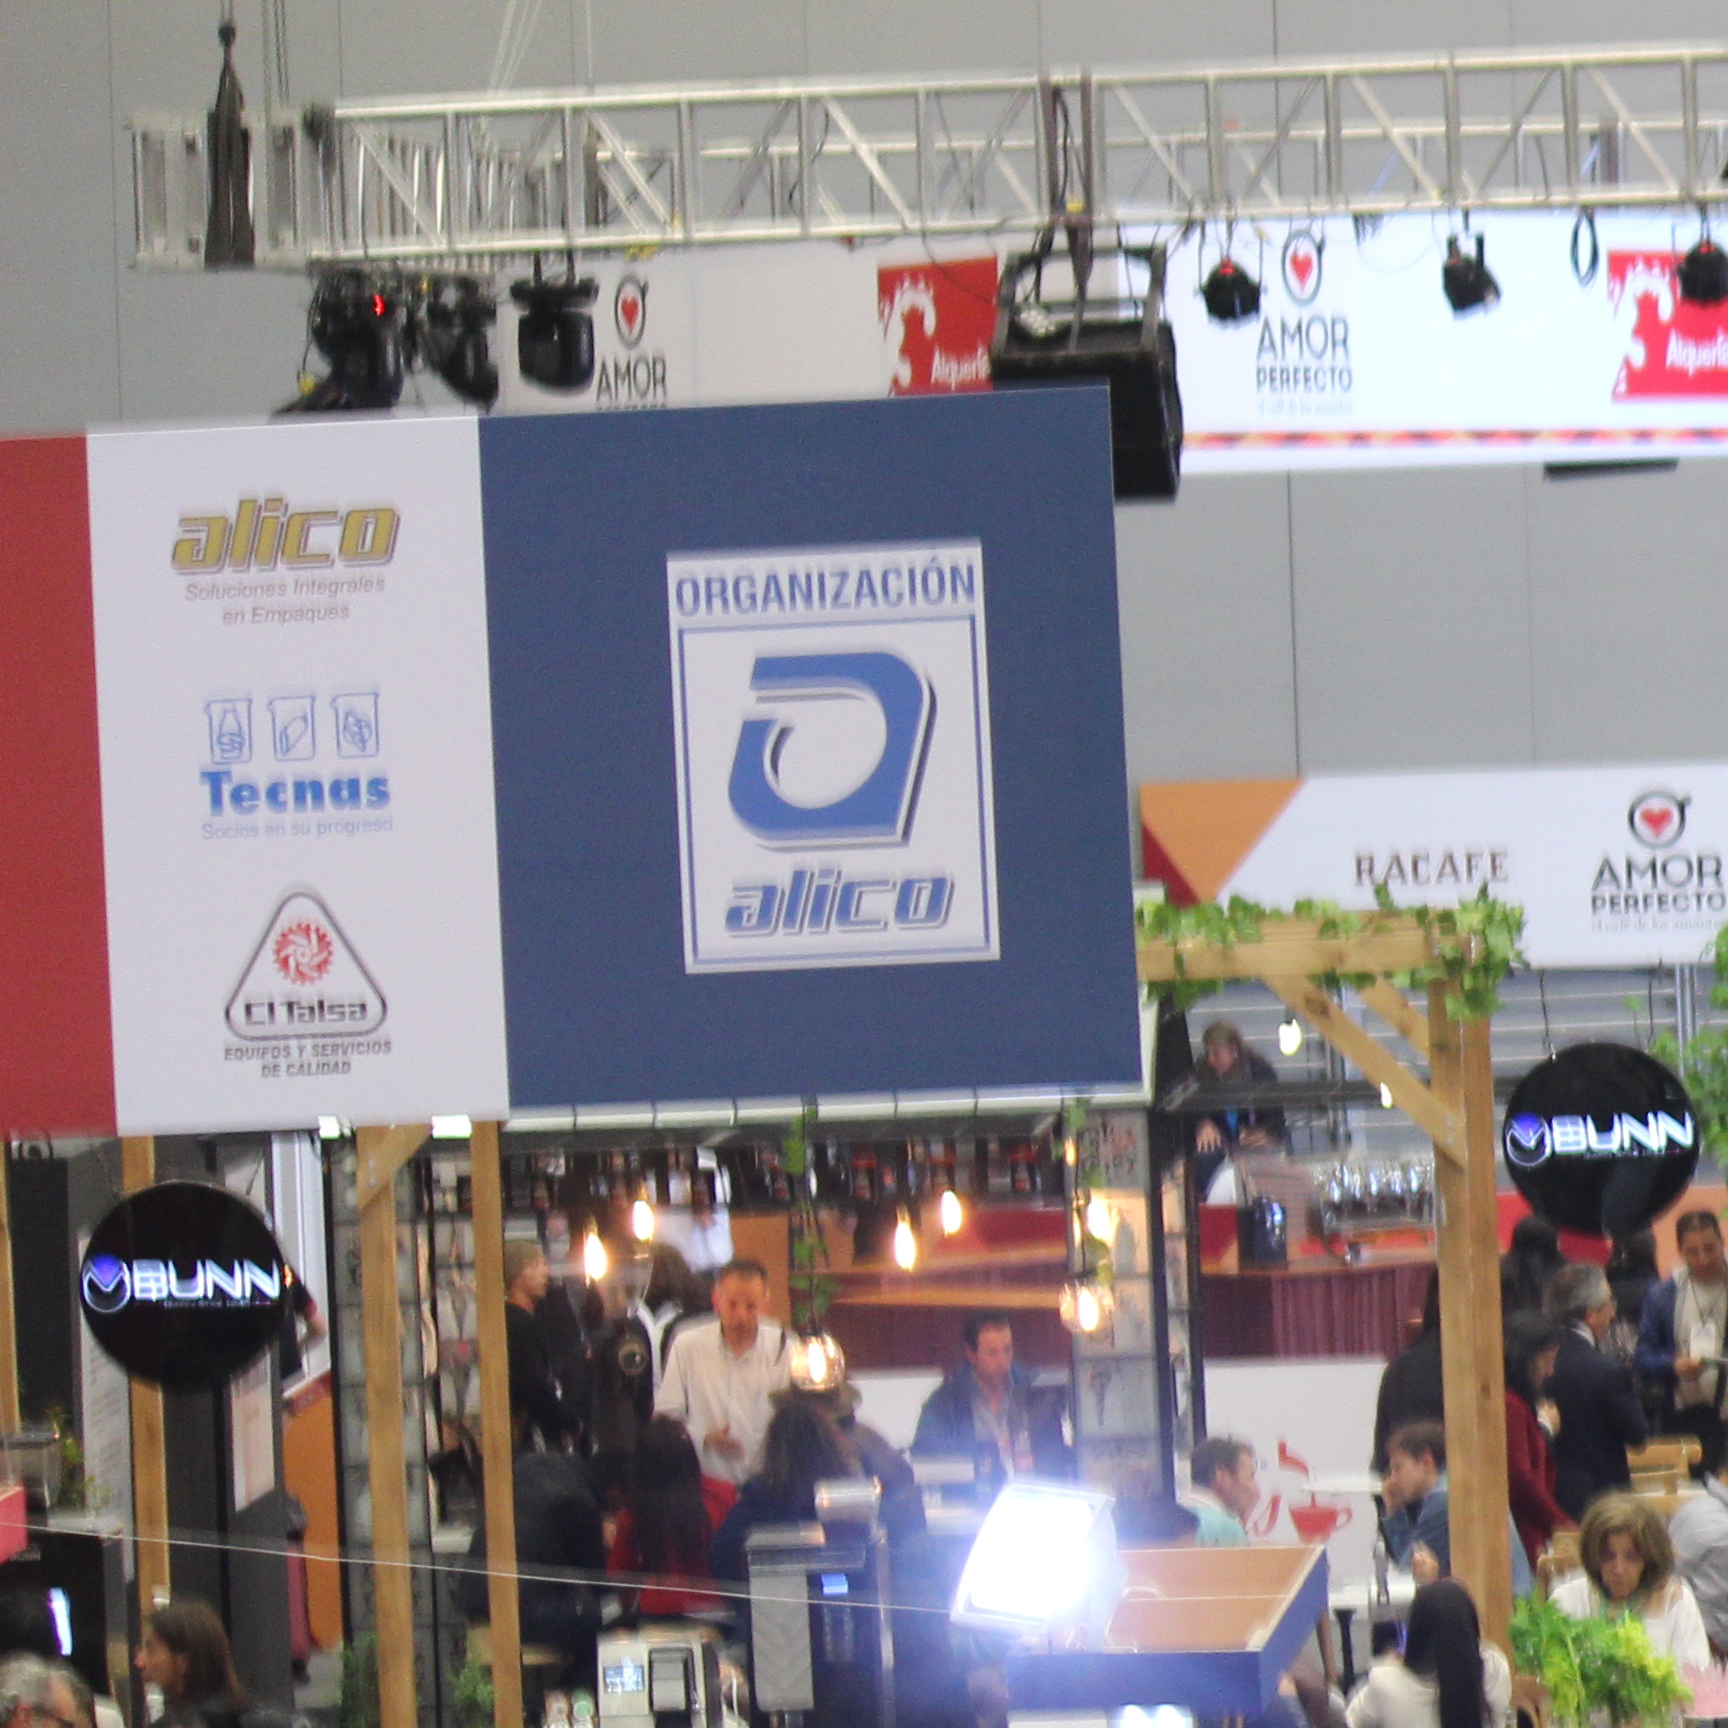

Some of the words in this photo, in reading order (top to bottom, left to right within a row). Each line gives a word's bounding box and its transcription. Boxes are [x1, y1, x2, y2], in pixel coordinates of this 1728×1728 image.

[1256, 314, 1350, 361] AMOR
[596, 354, 667, 402] AMOR
[1256, 366, 1353, 394] PERFECTO
[171, 497, 400, 576] alico
[184, 582, 288, 601] Soluciones
[294, 576, 386, 598] Integrales
[676, 556, 977, 618] ORGANIZACIÓN
[222, 609, 246, 625] en
[251, 605, 350, 627] Empaques
[200, 769, 391, 817] Tecnas
[202, 822, 261, 840] Socios
[317, 818, 394, 838] progreso
[1591, 851, 1724, 890] AMOR
[724, 867, 955, 940] alico
[1592, 890, 1728, 916] PERFECTO
[244, 1000, 275, 1026] CI
[279, 998, 368, 1025] Talsa
[224, 1044, 291, 1062] EQUIPOS
[297, 1044, 306, 1059] Y
[311, 1039, 392, 1058] SERVICIOS
[261, 1063, 282, 1078] DE
[286, 1061, 352, 1077] CALIDAD
[1552, 1110, 1694, 1155] BUNN
[132, 1258, 281, 1301] BUNN
